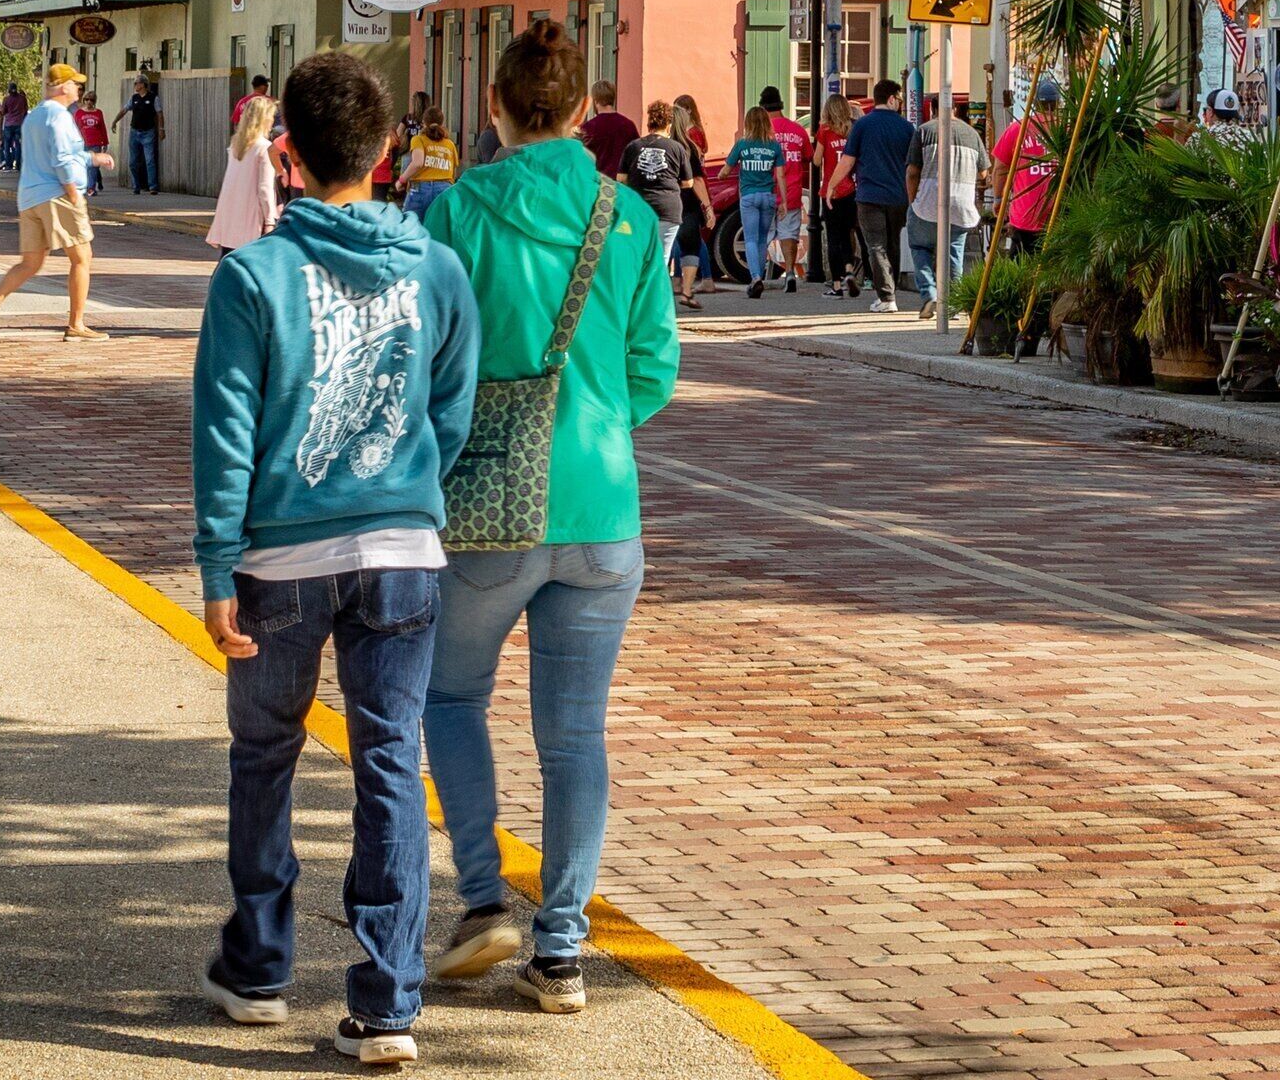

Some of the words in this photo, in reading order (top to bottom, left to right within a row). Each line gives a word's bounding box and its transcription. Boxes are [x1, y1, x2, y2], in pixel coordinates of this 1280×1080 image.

[347, 23, 369, 36] Wine
[371, 23, 388, 36] Bar
[742, 159, 775, 171] ATTITUDE
